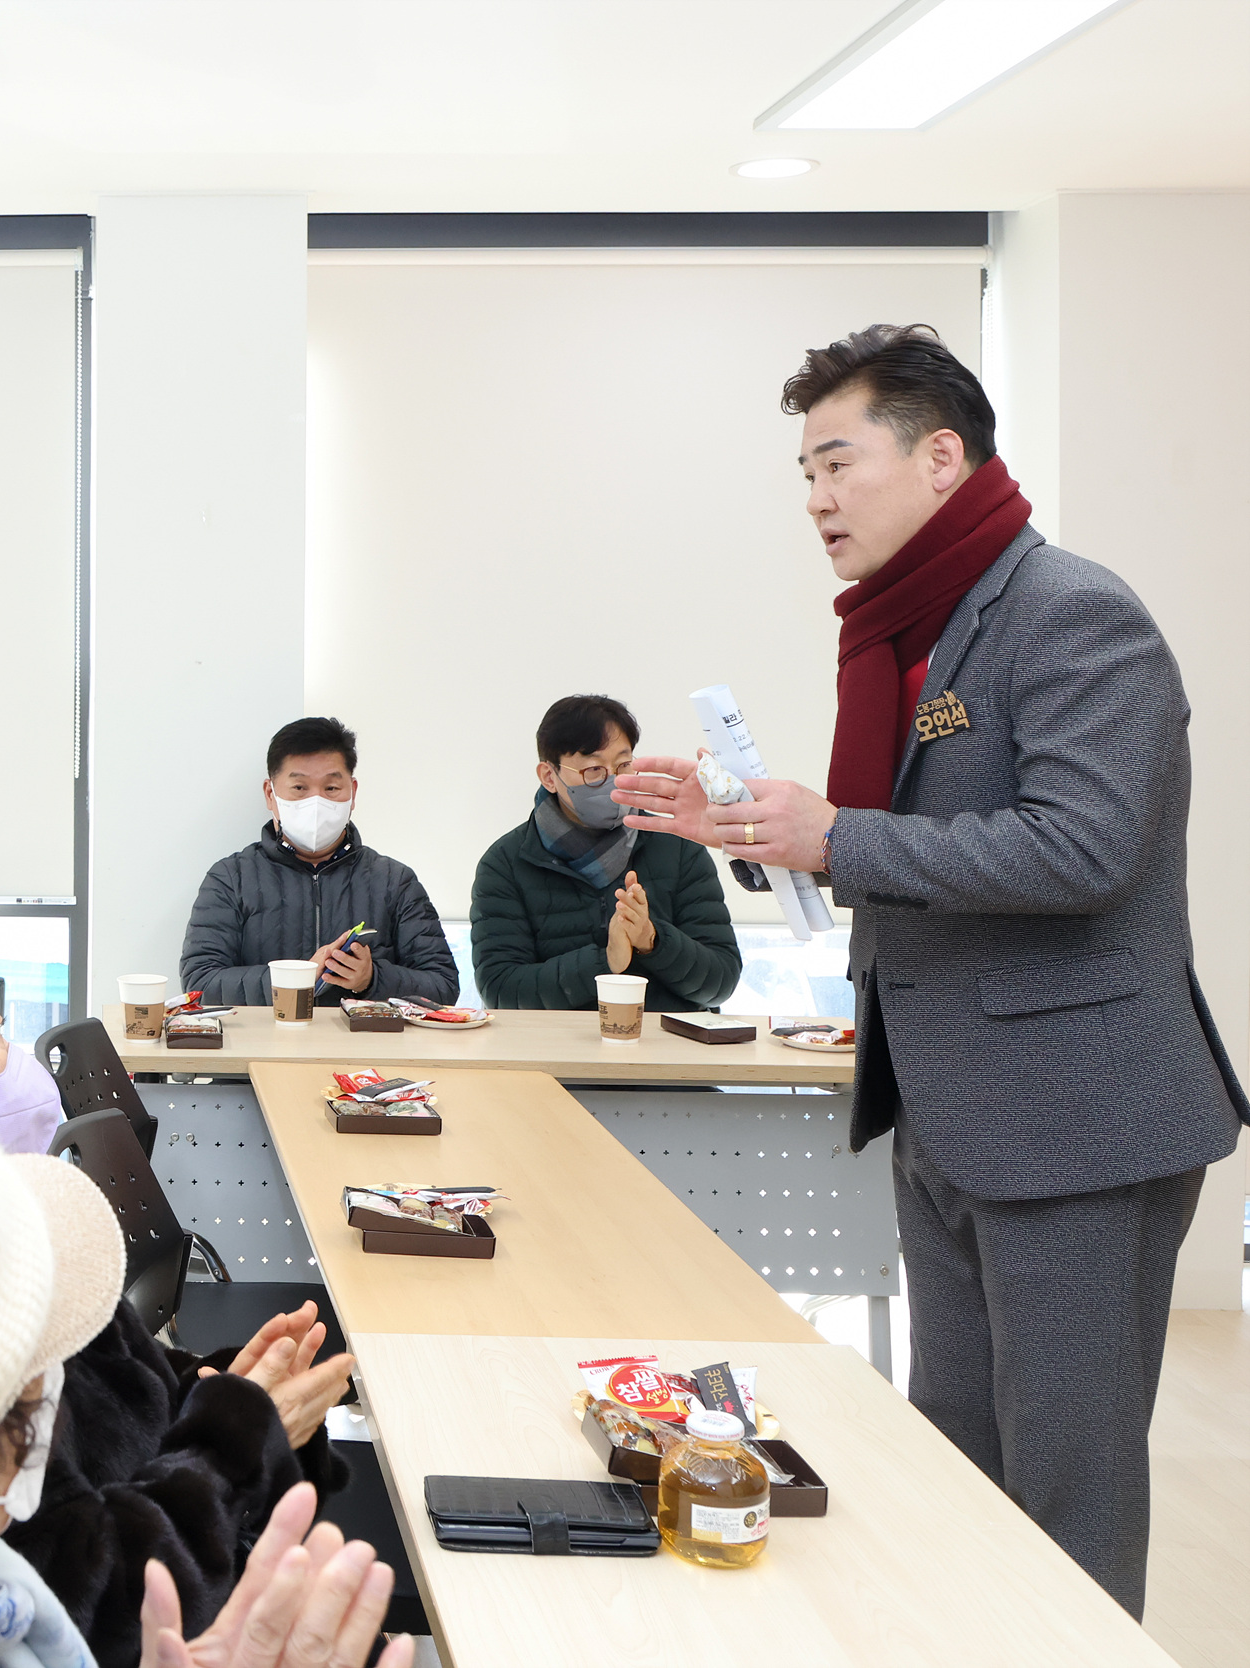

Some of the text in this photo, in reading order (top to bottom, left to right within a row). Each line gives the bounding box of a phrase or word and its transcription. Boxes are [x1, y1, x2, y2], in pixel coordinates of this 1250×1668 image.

[915, 702, 970, 742] 오언석
[589, 1366, 616, 1376] CROWN
[704, 1368, 729, 1402] 쿠크다스
